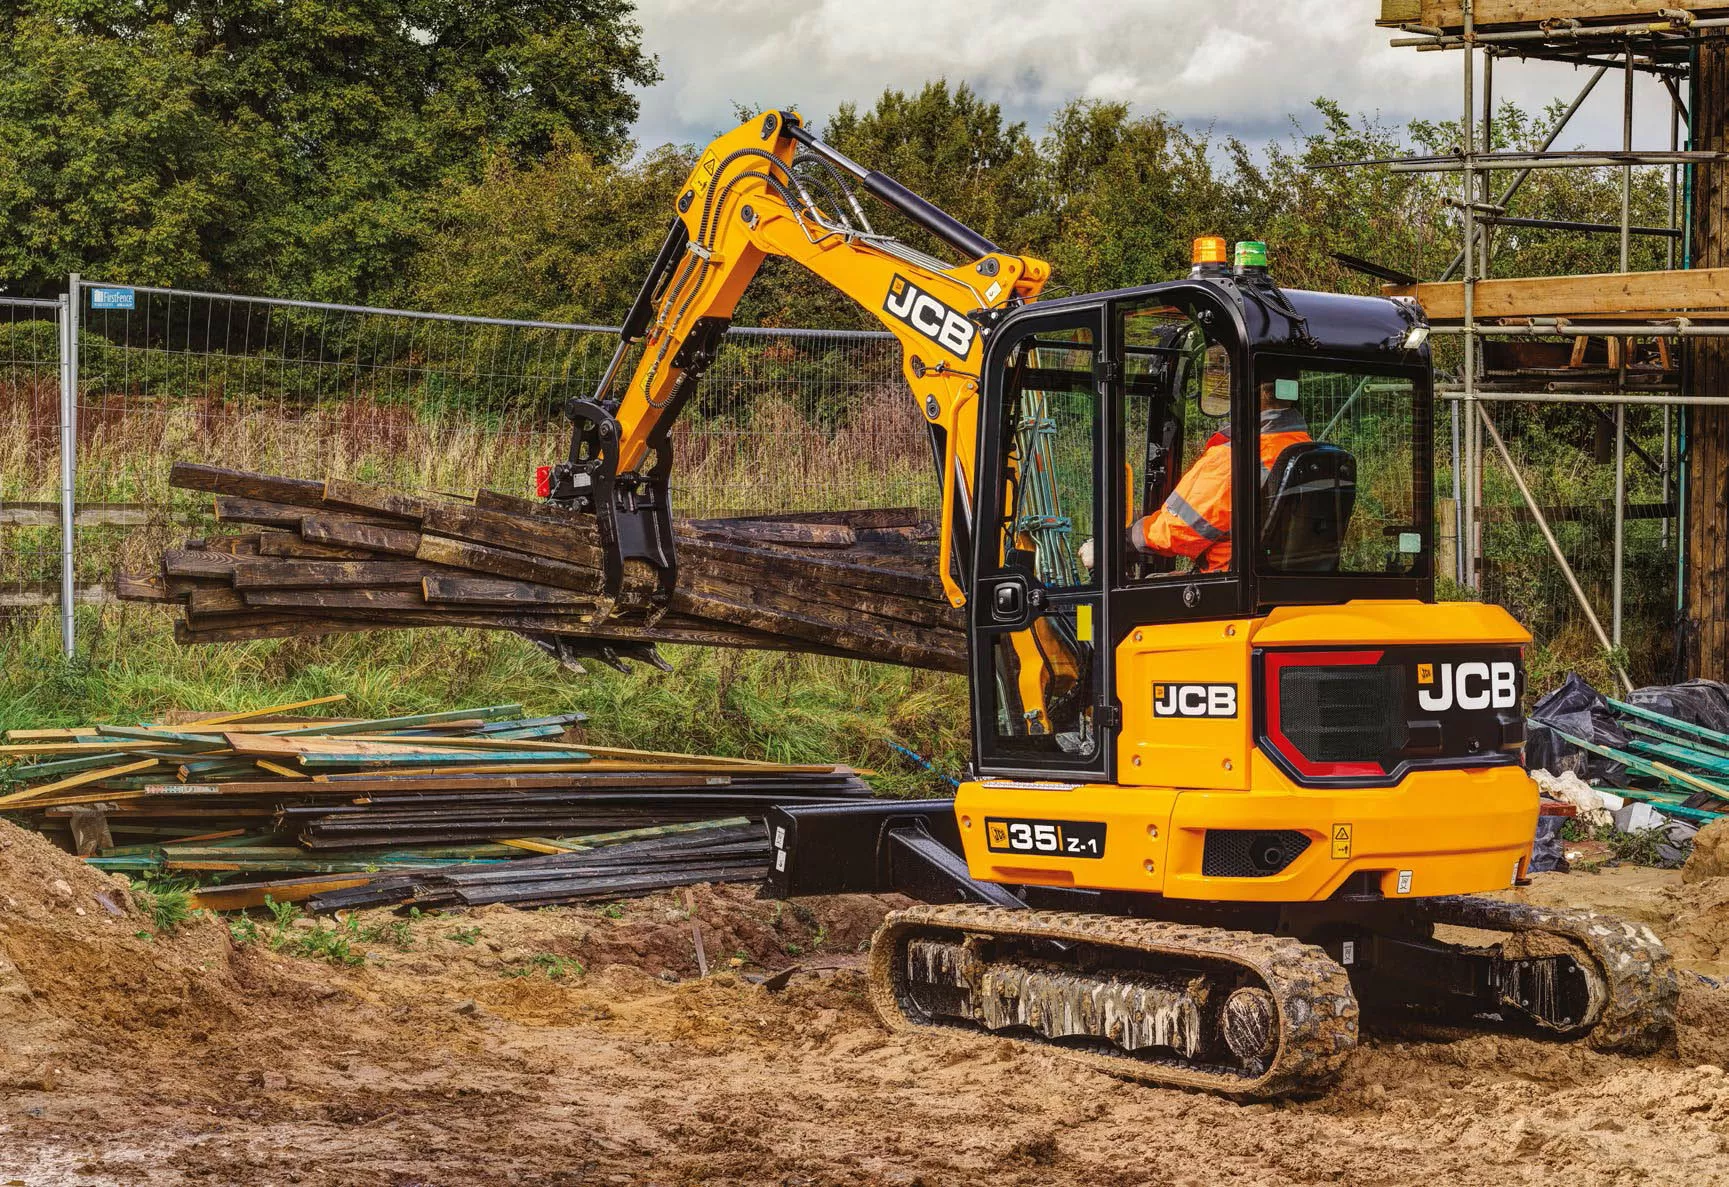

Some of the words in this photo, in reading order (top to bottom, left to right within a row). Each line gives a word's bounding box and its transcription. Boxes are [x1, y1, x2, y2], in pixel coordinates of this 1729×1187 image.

[104, 291, 132, 303] FirstFence
[887, 286, 974, 355] JCB
[1155, 686, 1236, 716] JCB
[1419, 662, 1516, 711] JCB
[1010, 823, 1057, 851] 35
[1067, 837, 1097, 854] Z-1
